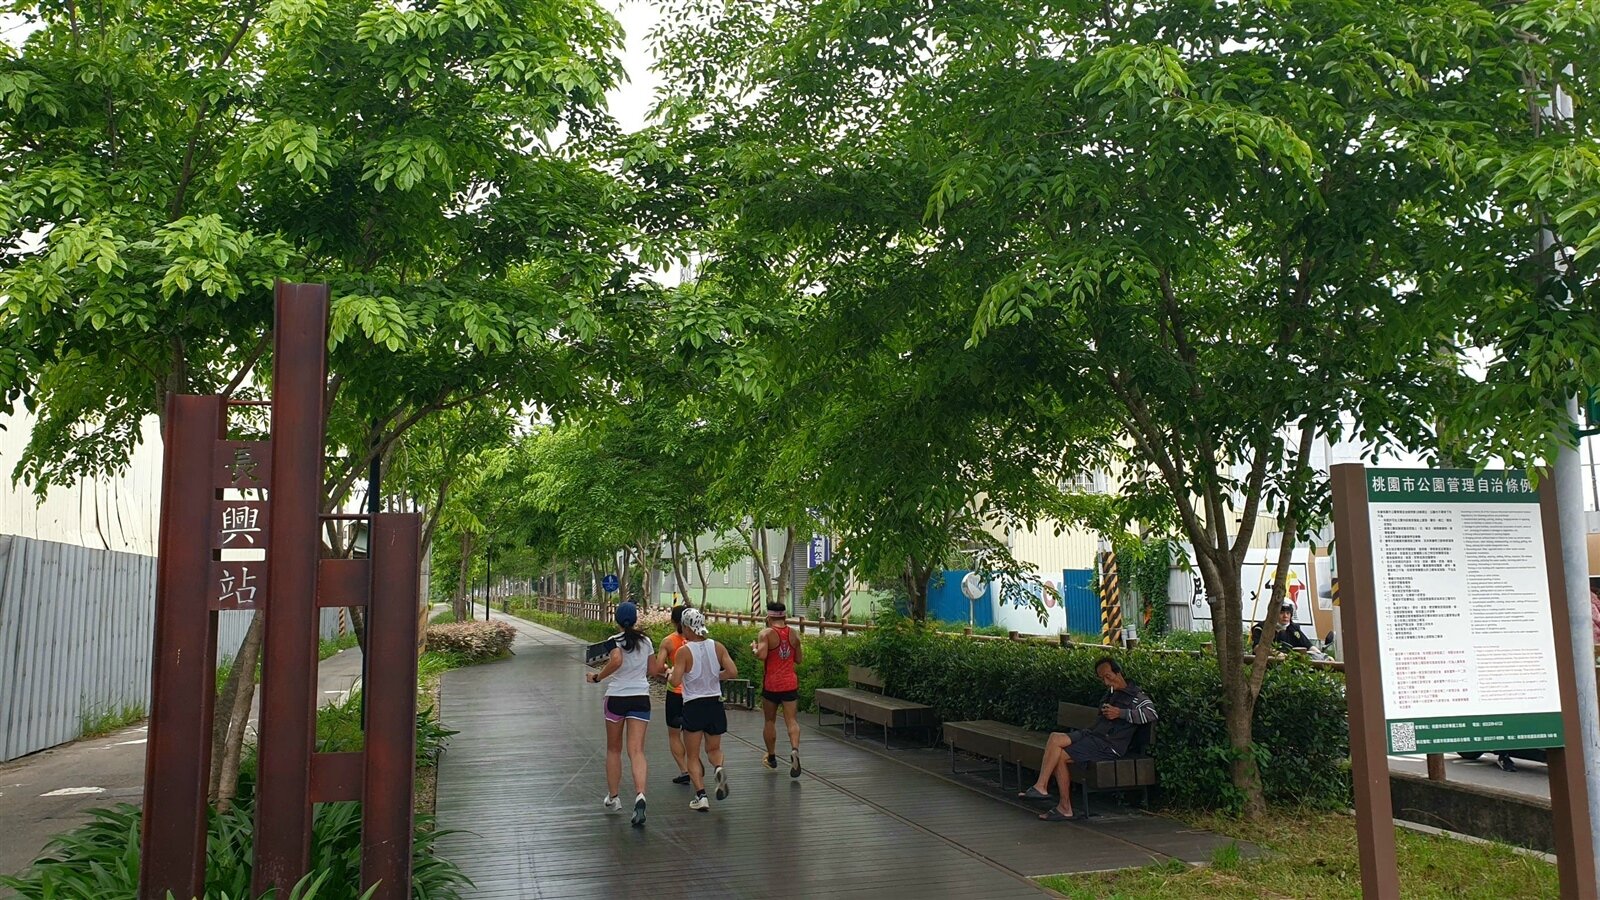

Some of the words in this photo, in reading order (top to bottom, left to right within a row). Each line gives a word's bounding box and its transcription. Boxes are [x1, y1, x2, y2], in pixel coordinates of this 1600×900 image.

[218, 447, 262, 604] 長興站
[1372, 476, 1534, 493] 桃園市公園管理自治條例
